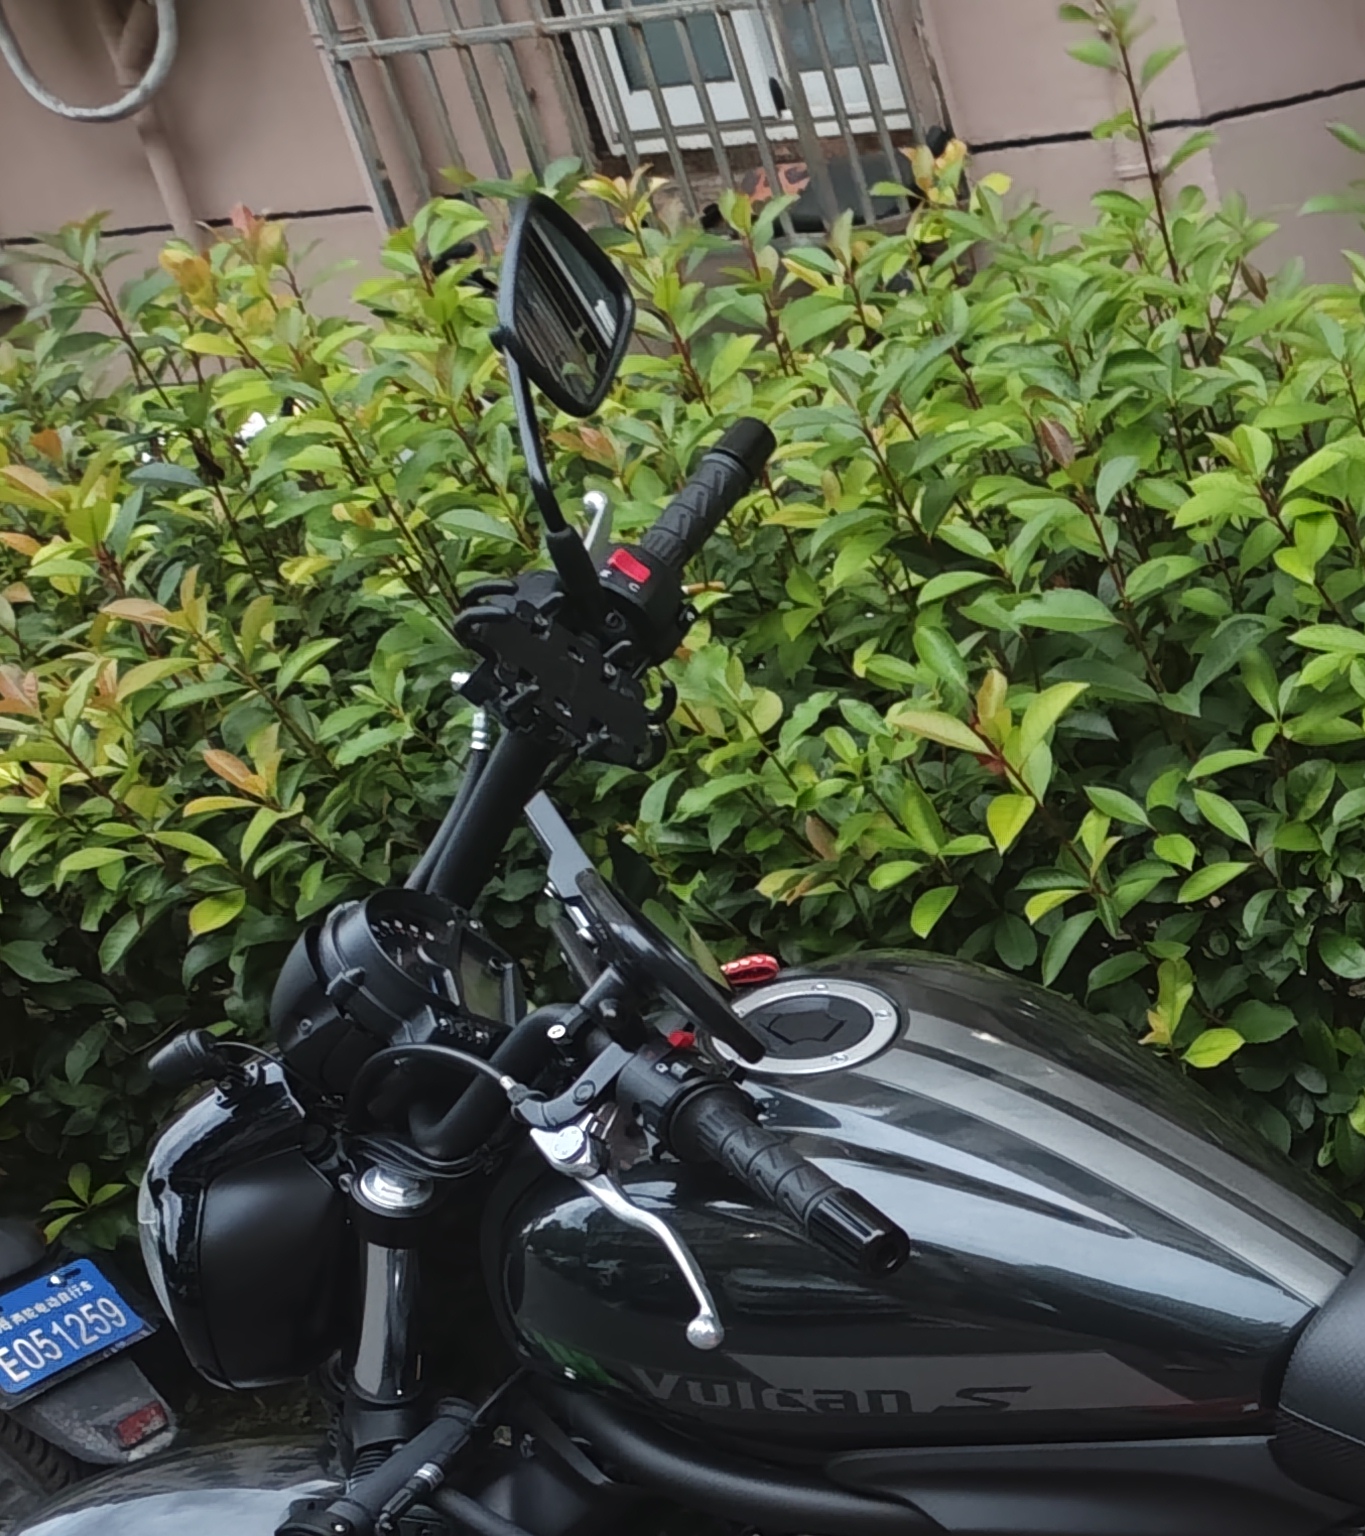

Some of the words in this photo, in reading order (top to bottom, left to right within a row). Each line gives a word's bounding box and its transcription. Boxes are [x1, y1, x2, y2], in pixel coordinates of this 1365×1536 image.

[0, 1298, 127, 1383] E051259
[632, 1367, 916, 1414] Vulcan
[931, 1385, 1032, 1415] S
